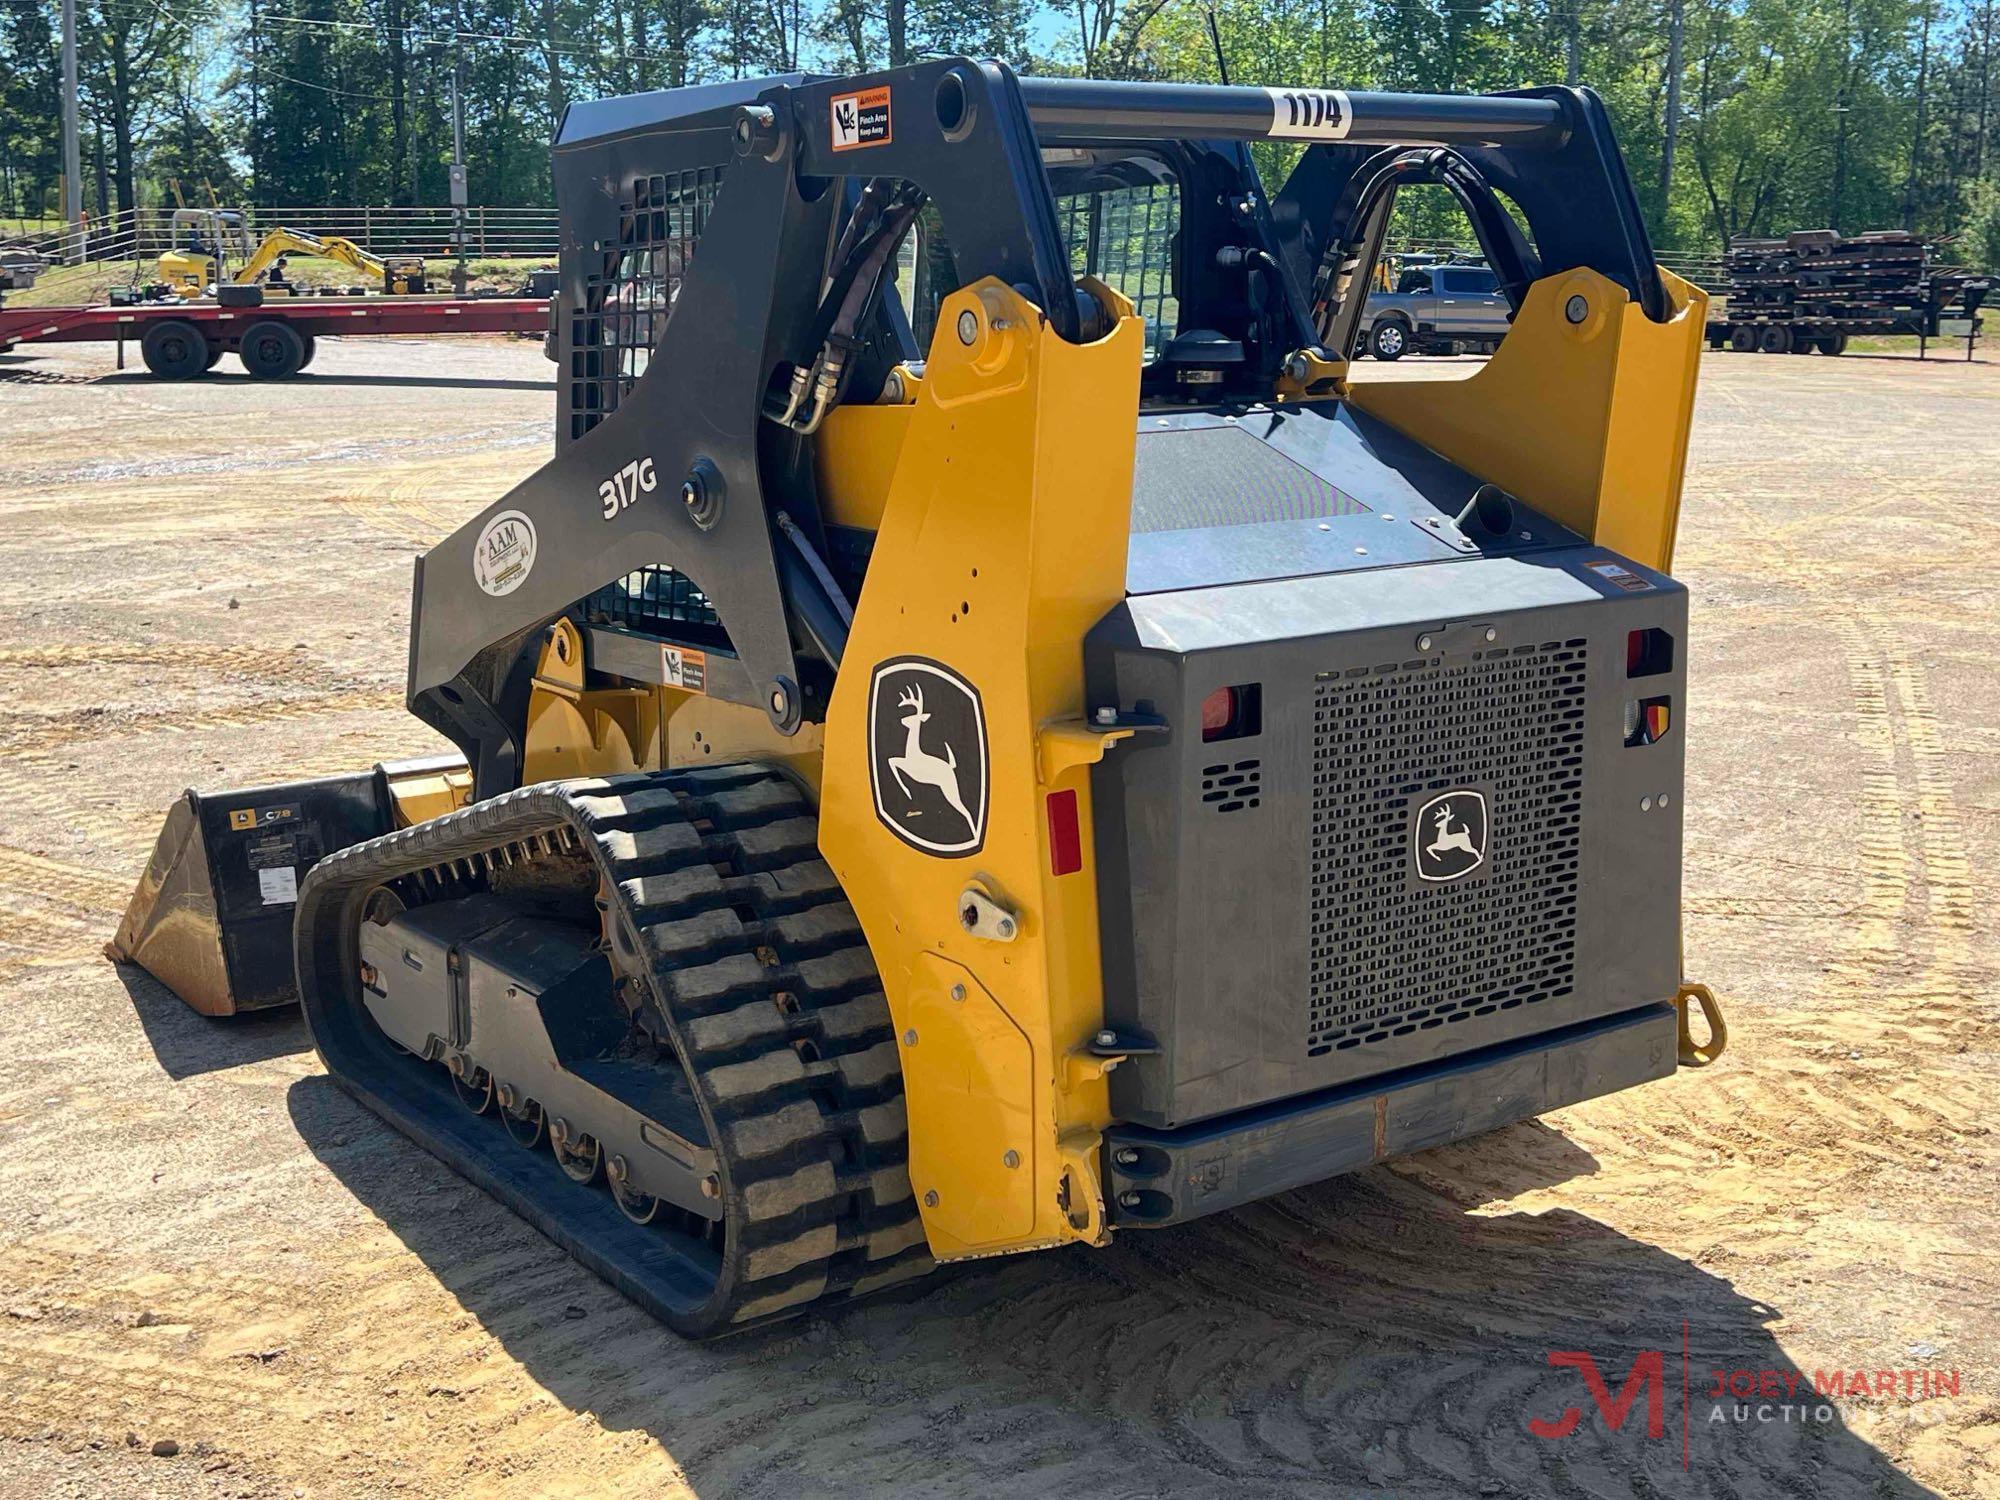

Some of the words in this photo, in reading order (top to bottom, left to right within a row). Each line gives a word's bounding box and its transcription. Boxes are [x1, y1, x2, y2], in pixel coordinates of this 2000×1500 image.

[864, 93, 888, 104] WARNING
[1283, 92, 1343, 128] 1174
[860, 115, 874, 125] Pinch
[875, 113, 887, 123] Area
[860, 128, 871, 136] Keep
[872, 126, 884, 135] Away
[598, 457, 658, 520] 317G
[487, 522, 518, 558] AAM
